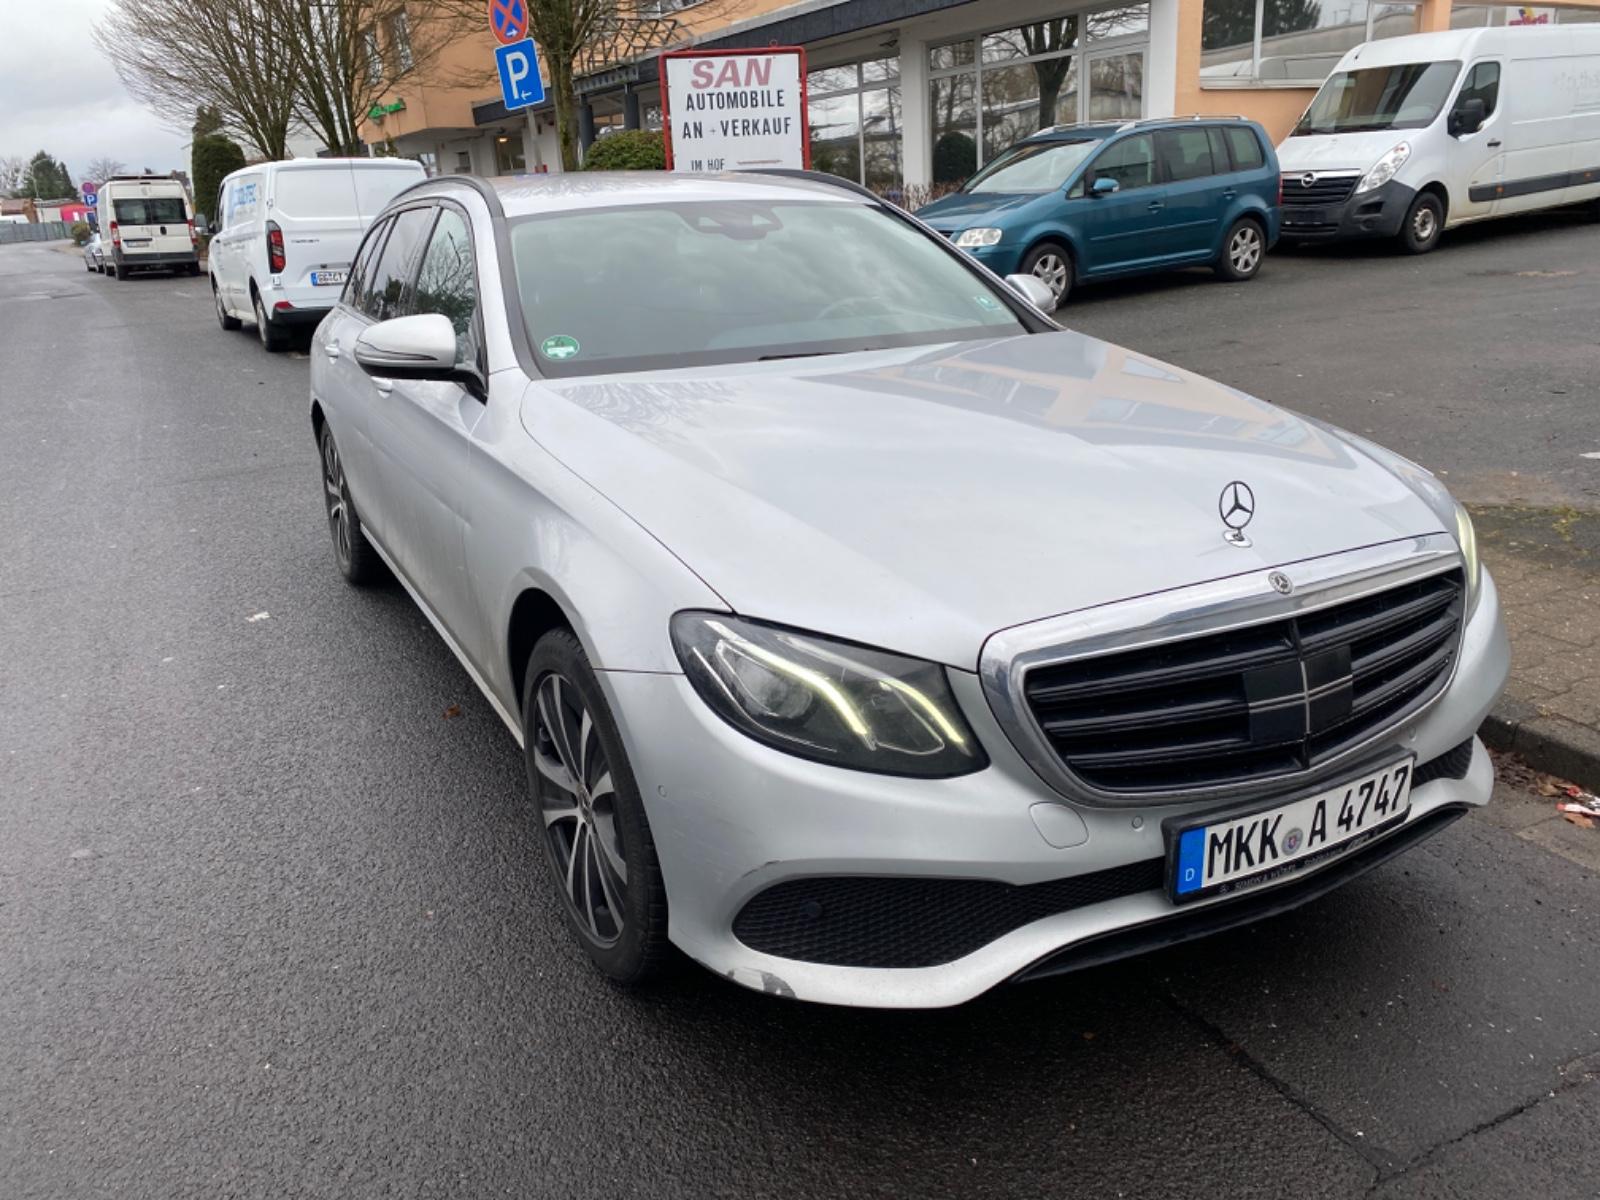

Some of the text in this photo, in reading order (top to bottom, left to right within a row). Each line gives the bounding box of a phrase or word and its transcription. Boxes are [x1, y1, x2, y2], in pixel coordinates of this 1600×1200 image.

[506, 52, 529, 99] P
[691, 58, 772, 89] SAN
[686, 90, 785, 111] AUTOMOBILE
[682, 122, 703, 139] AN
[720, 117, 791, 137] VERKAUF
[691, 158, 725, 171] IM HOF
[1207, 765, 1408, 878] MKK A 4747
[1185, 868, 1195, 882] D
